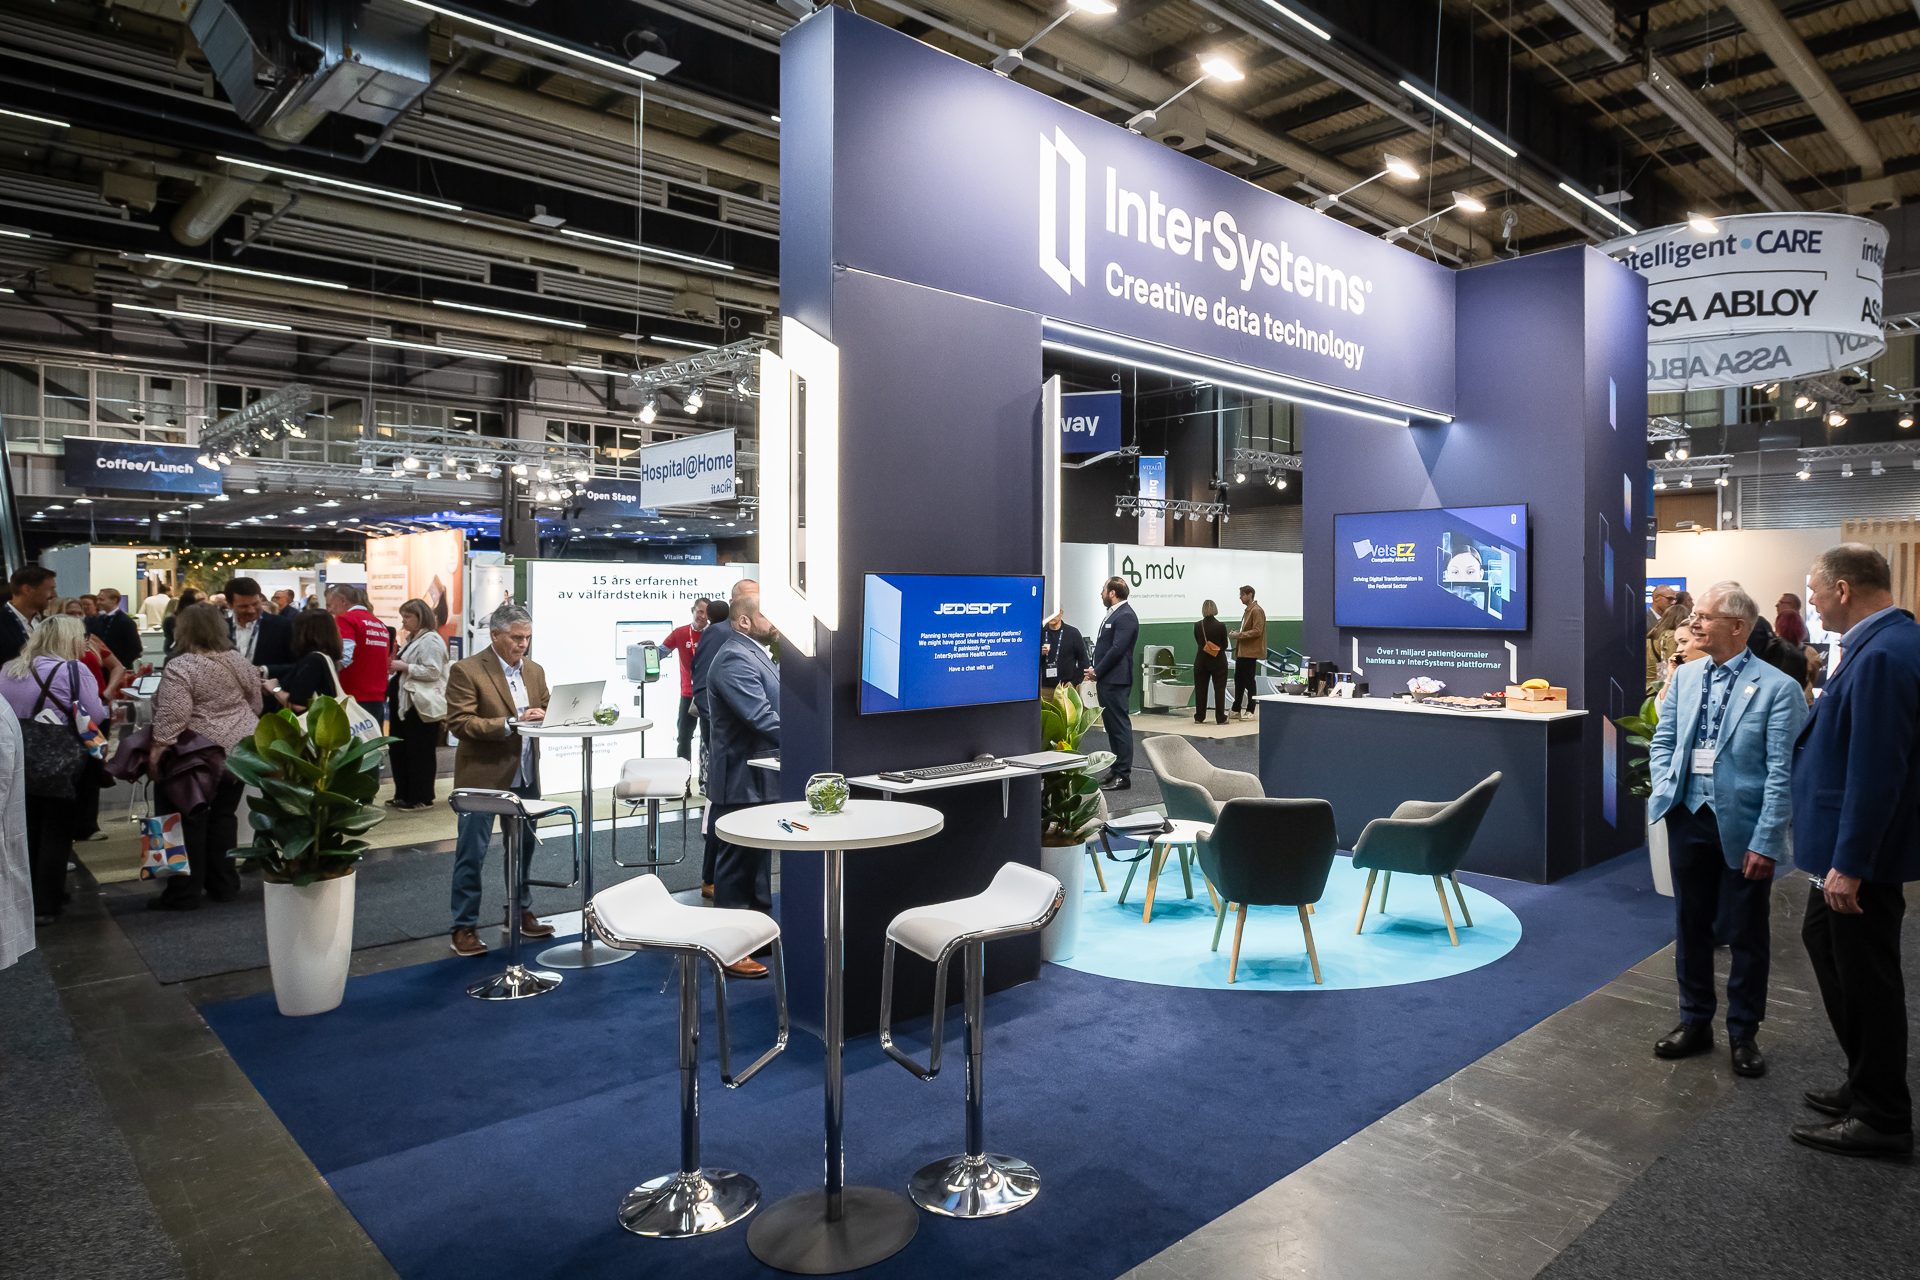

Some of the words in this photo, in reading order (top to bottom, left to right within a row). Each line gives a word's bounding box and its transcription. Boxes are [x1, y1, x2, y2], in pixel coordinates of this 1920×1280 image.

[1618, 234, 1737, 271] ntelligent
[1756, 230, 1823, 254] CARE
[1647, 296, 1698, 327] SA
[1703, 289, 1819, 320] ABLOY
[1105, 262, 1207, 321] Creative
[1213, 297, 1261, 336] data
[1265, 313, 1365, 371] technology
[96, 457, 194, 474] Coffee/Lunch
[641, 453, 733, 483] Hospital@Home
[587, 491, 610, 501] Open
[612, 492, 637, 503] Stage
[1371, 543, 1416, 557] VetsEZ
[1145, 557, 1185, 579] mdv
[592, 576, 607, 585] 15
[611, 575, 631, 586] års
[635, 576, 698, 586] erfarenhet
[558, 591, 574, 599] av
[578, 589, 668, 600] välfärdsteknik
[672, 590, 675, 599] i
[679, 590, 726, 600] hemmet
[934, 603, 1012, 614] JEDISOFT
[1376, 647, 1394, 655] Över
[1400, 649, 1426, 657] miljard
[1427, 650, 1489, 659] patientjournaler
[1365, 657, 1396, 665] hanteras
[1407, 658, 1455, 668] InterSystems
[1456, 660, 1502, 669] plattformar
